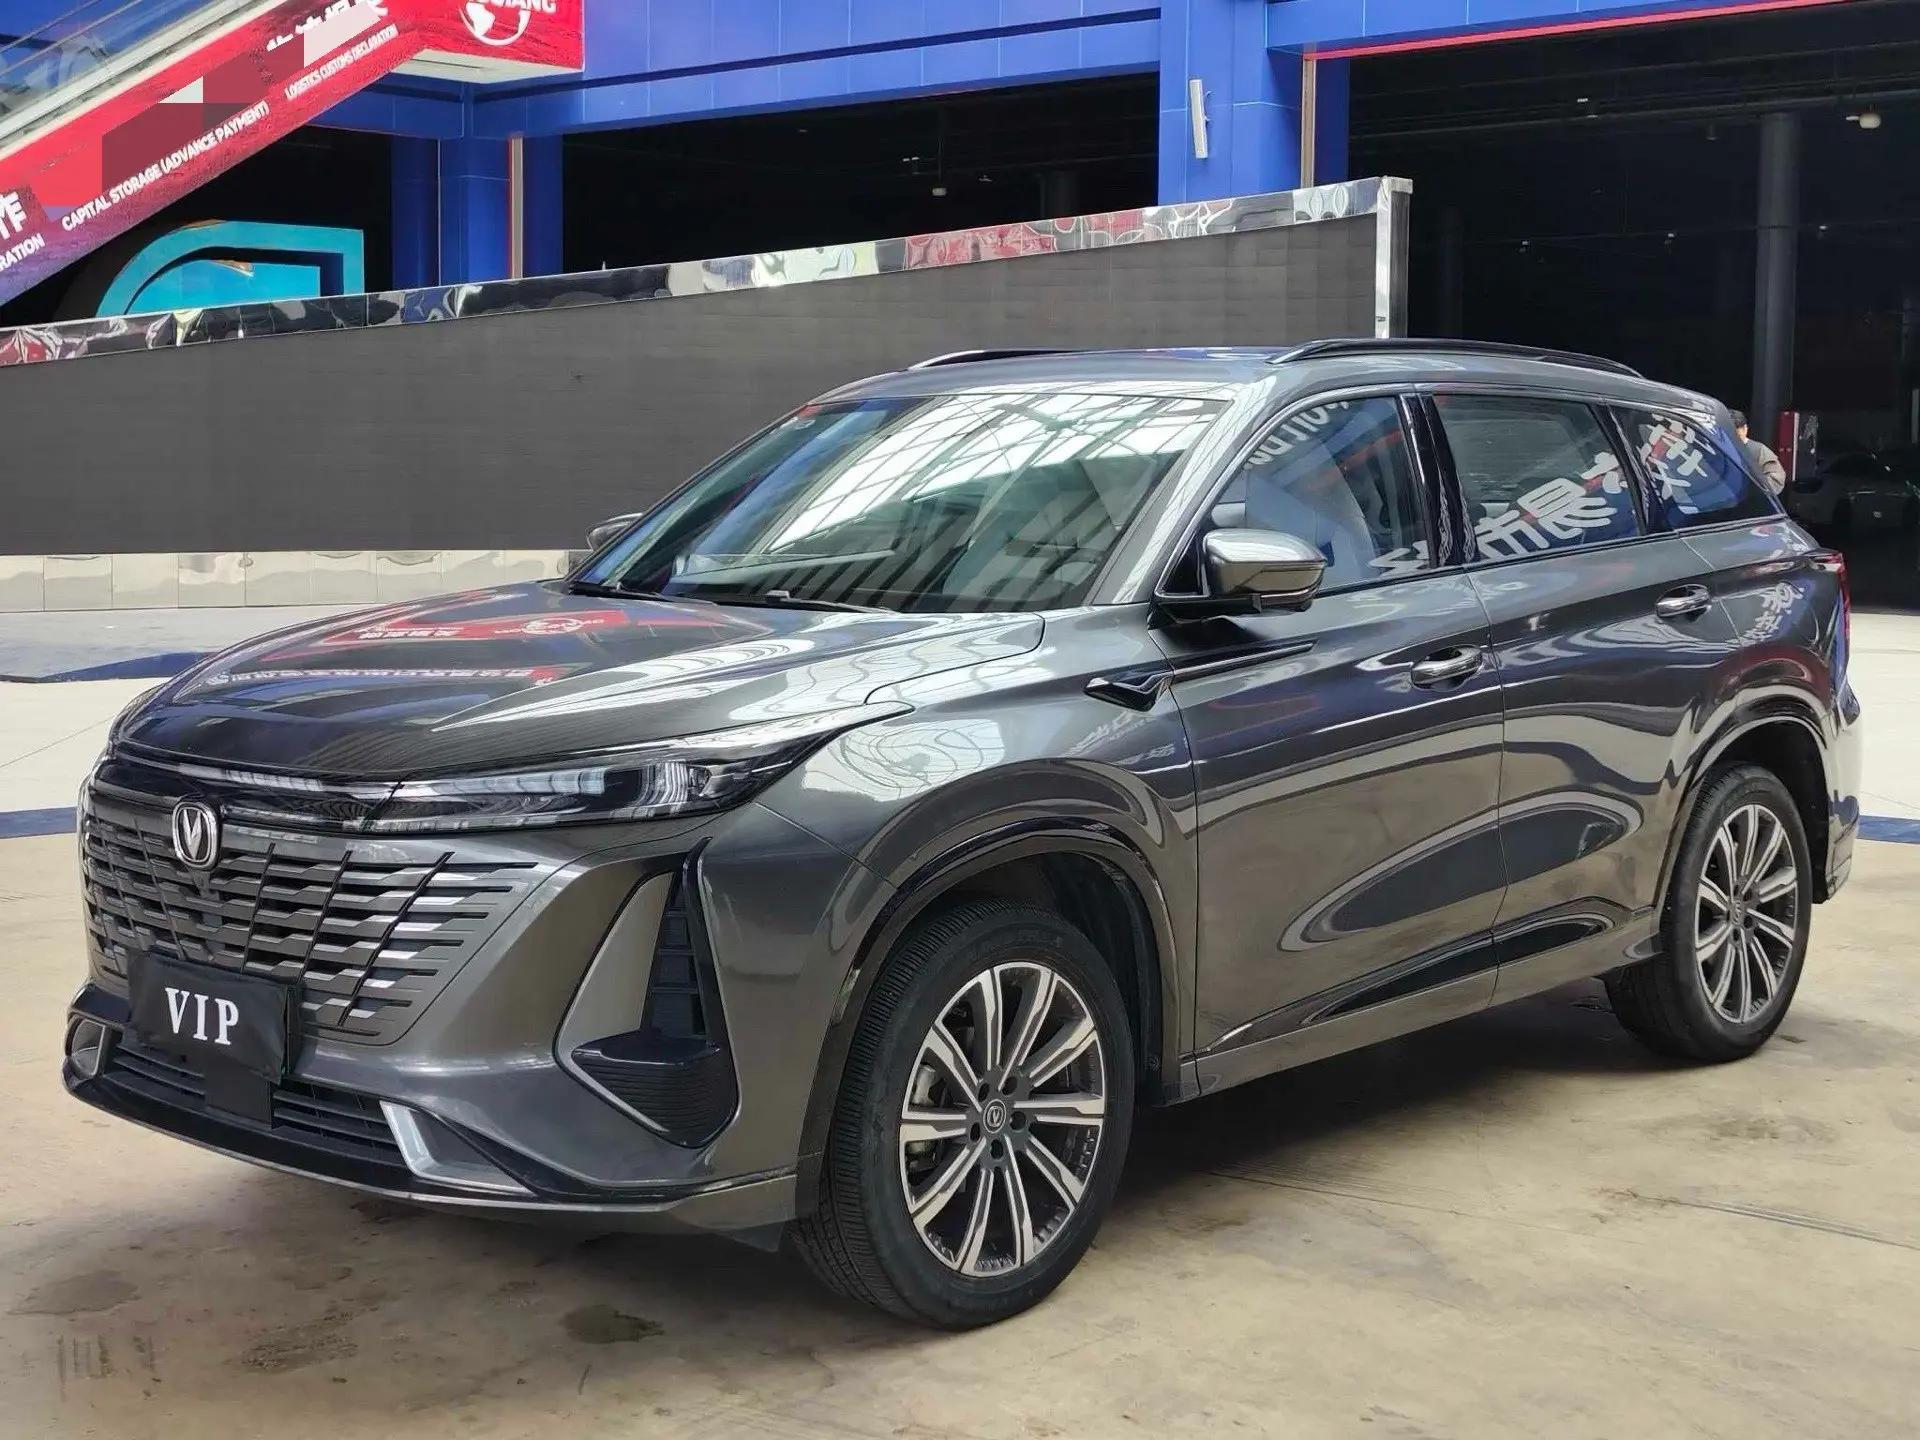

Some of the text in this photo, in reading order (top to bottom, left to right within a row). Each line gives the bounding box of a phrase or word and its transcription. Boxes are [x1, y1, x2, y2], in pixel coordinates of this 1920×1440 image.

[62, 100, 270, 231] CAPITAL STORAGE (ADVANCE PAYMENT)
[165, 987, 239, 1046] VIP
